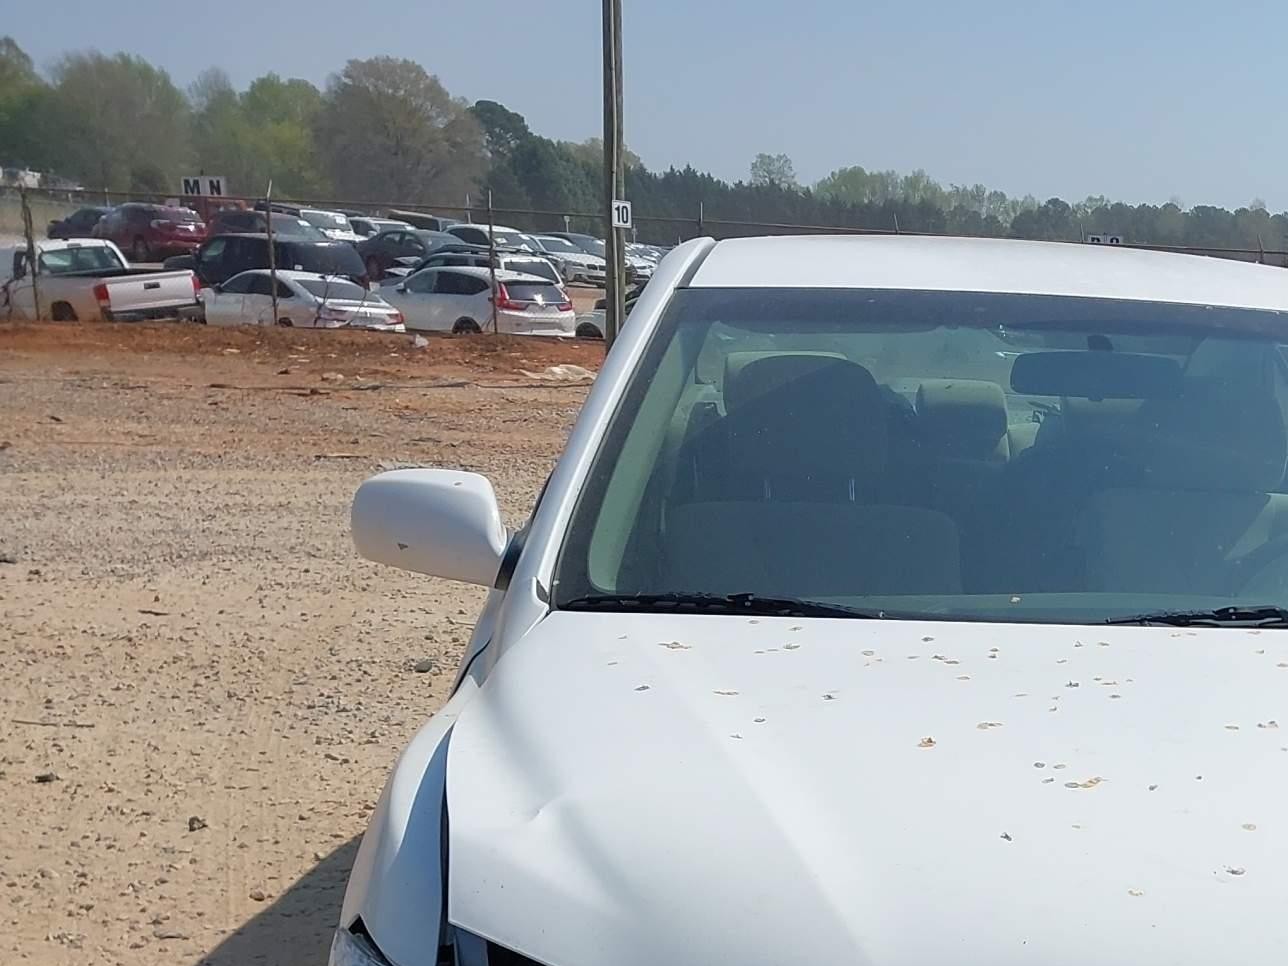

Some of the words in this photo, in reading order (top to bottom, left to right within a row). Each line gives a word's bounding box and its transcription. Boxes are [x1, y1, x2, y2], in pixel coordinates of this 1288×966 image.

[184, 179, 201, 195] M
[209, 179, 222, 196] N
[614, 205, 629, 224] 10
